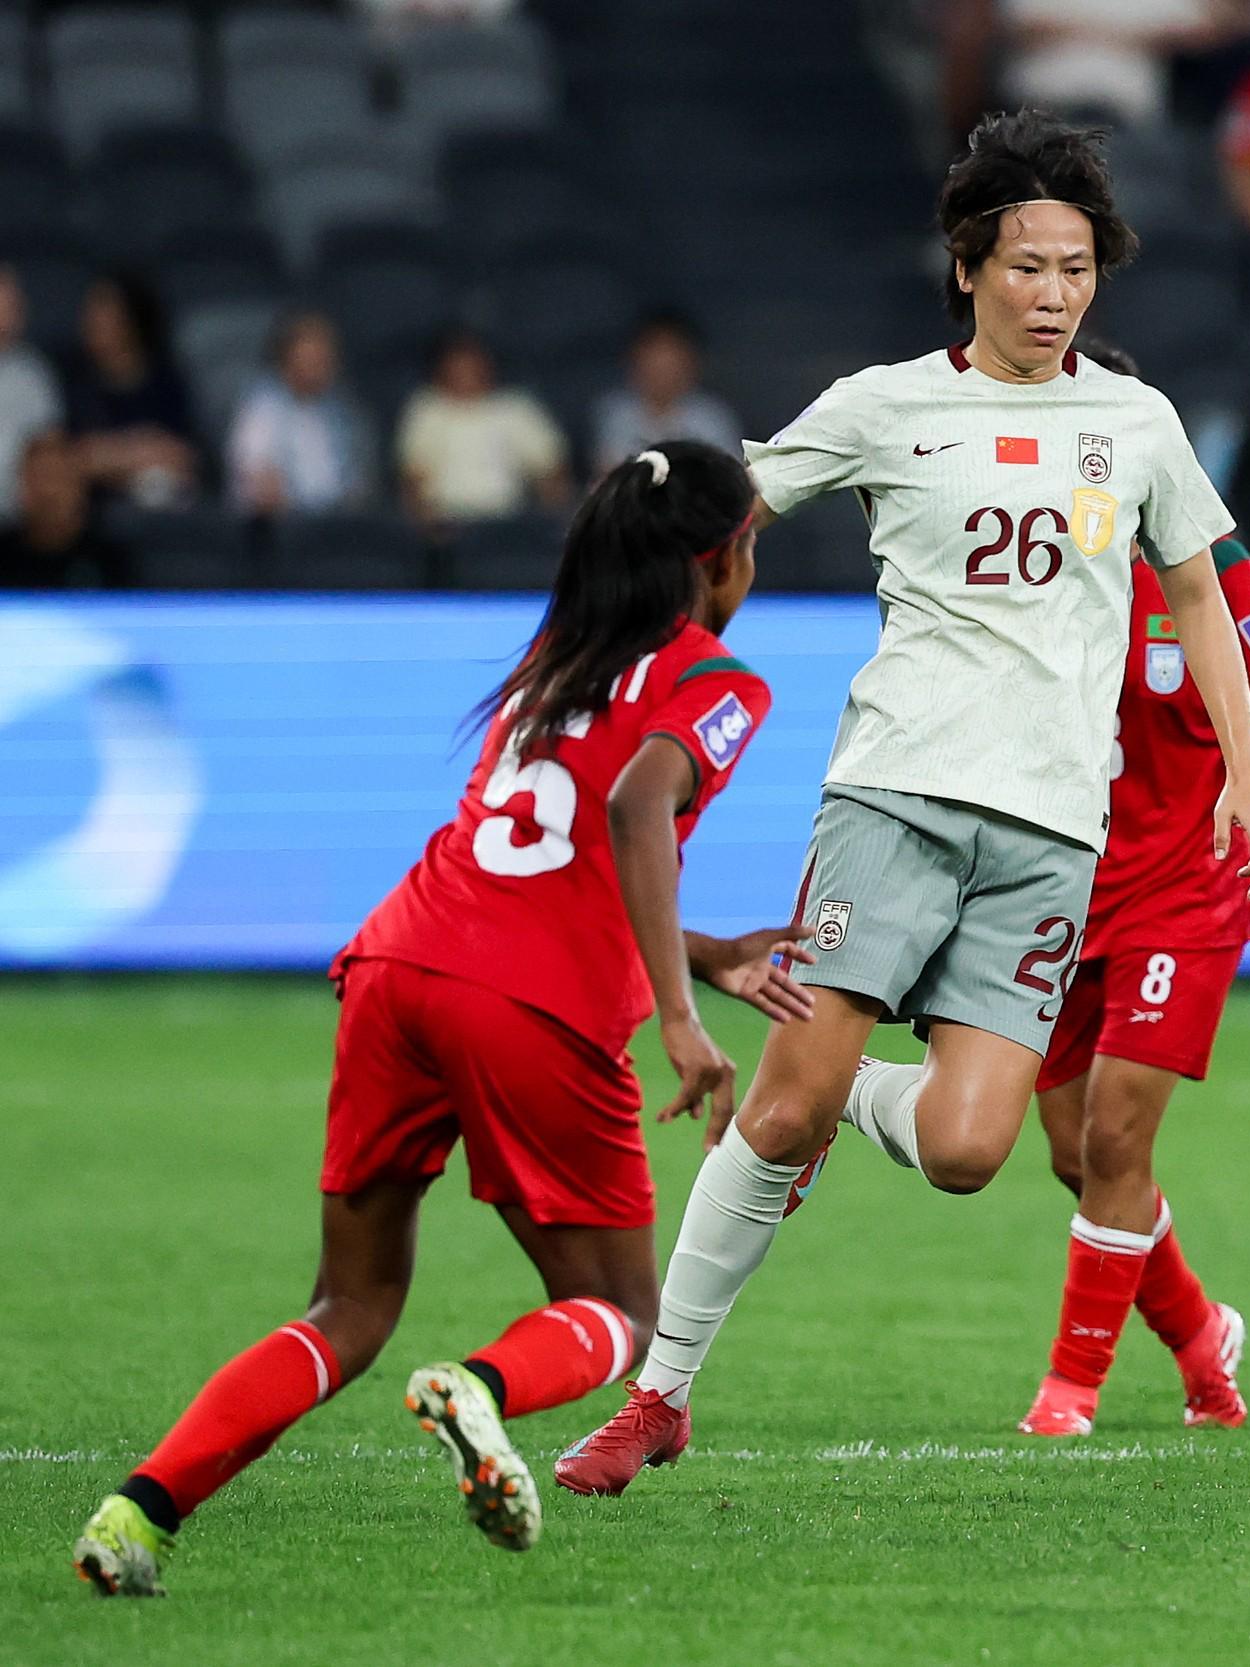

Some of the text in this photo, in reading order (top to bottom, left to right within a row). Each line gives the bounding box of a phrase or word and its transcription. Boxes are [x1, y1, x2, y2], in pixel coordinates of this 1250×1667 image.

[1081, 436, 1110, 448] CFA
[964, 506, 1069, 585] 26
[472, 709, 594, 878] 5
[822, 903, 849, 914] CFA
[1140, 952, 1177, 1005] 8
